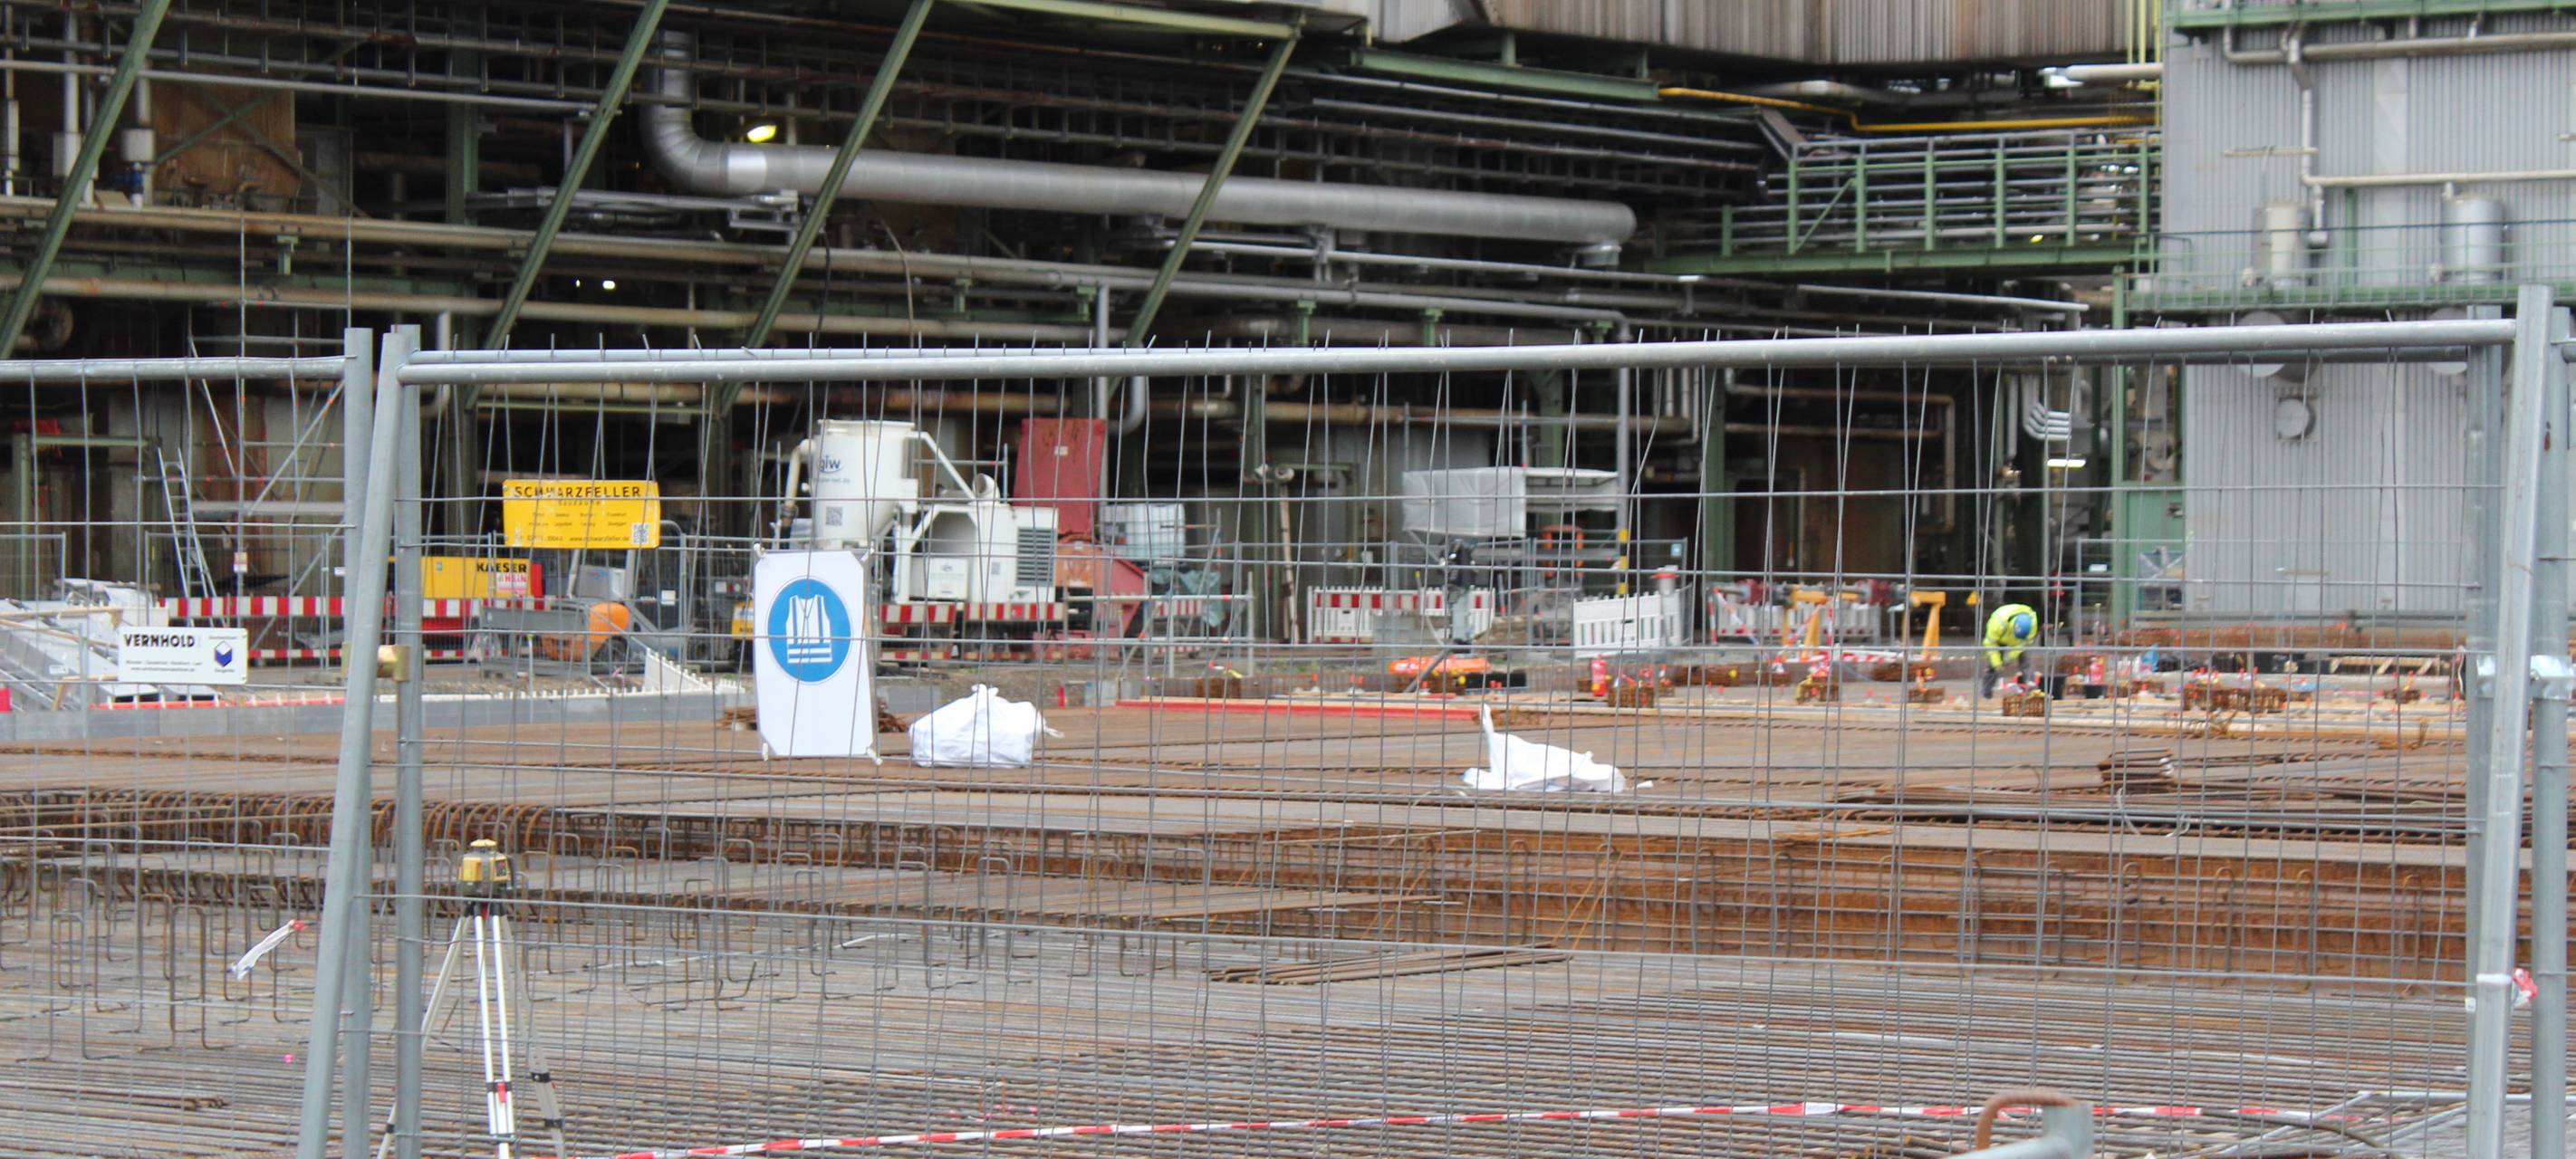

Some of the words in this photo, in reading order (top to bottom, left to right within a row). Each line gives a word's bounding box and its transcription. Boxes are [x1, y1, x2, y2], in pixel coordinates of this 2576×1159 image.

[514, 486, 641, 498] SCHWARZFELLER
[476, 562, 527, 573] KAESER
[123, 634, 195, 647] VERNHOLD
